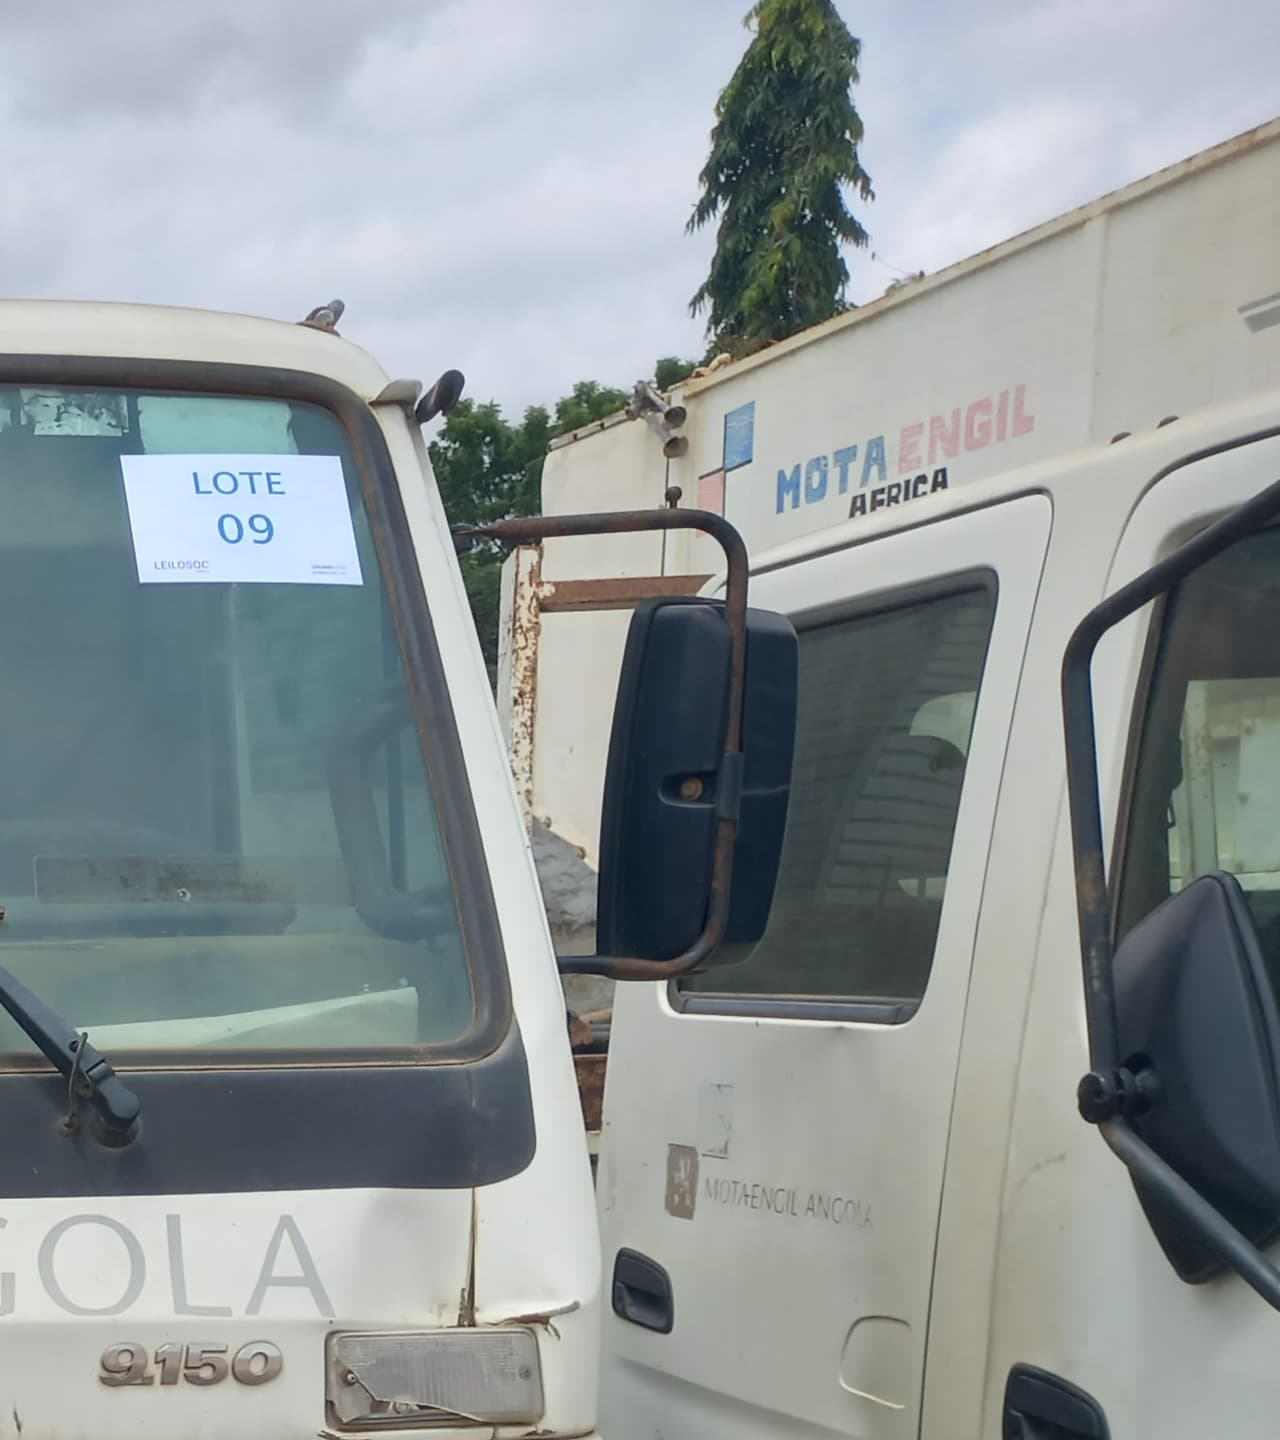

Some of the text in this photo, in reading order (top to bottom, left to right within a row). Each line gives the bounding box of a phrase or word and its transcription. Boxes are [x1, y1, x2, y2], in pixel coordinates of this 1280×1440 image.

[776, 384, 1035, 514] MOTA ENGIL
[192, 471, 285, 495] LOTE
[849, 467, 948, 518] AFRICA
[217, 513, 275, 545] 09
